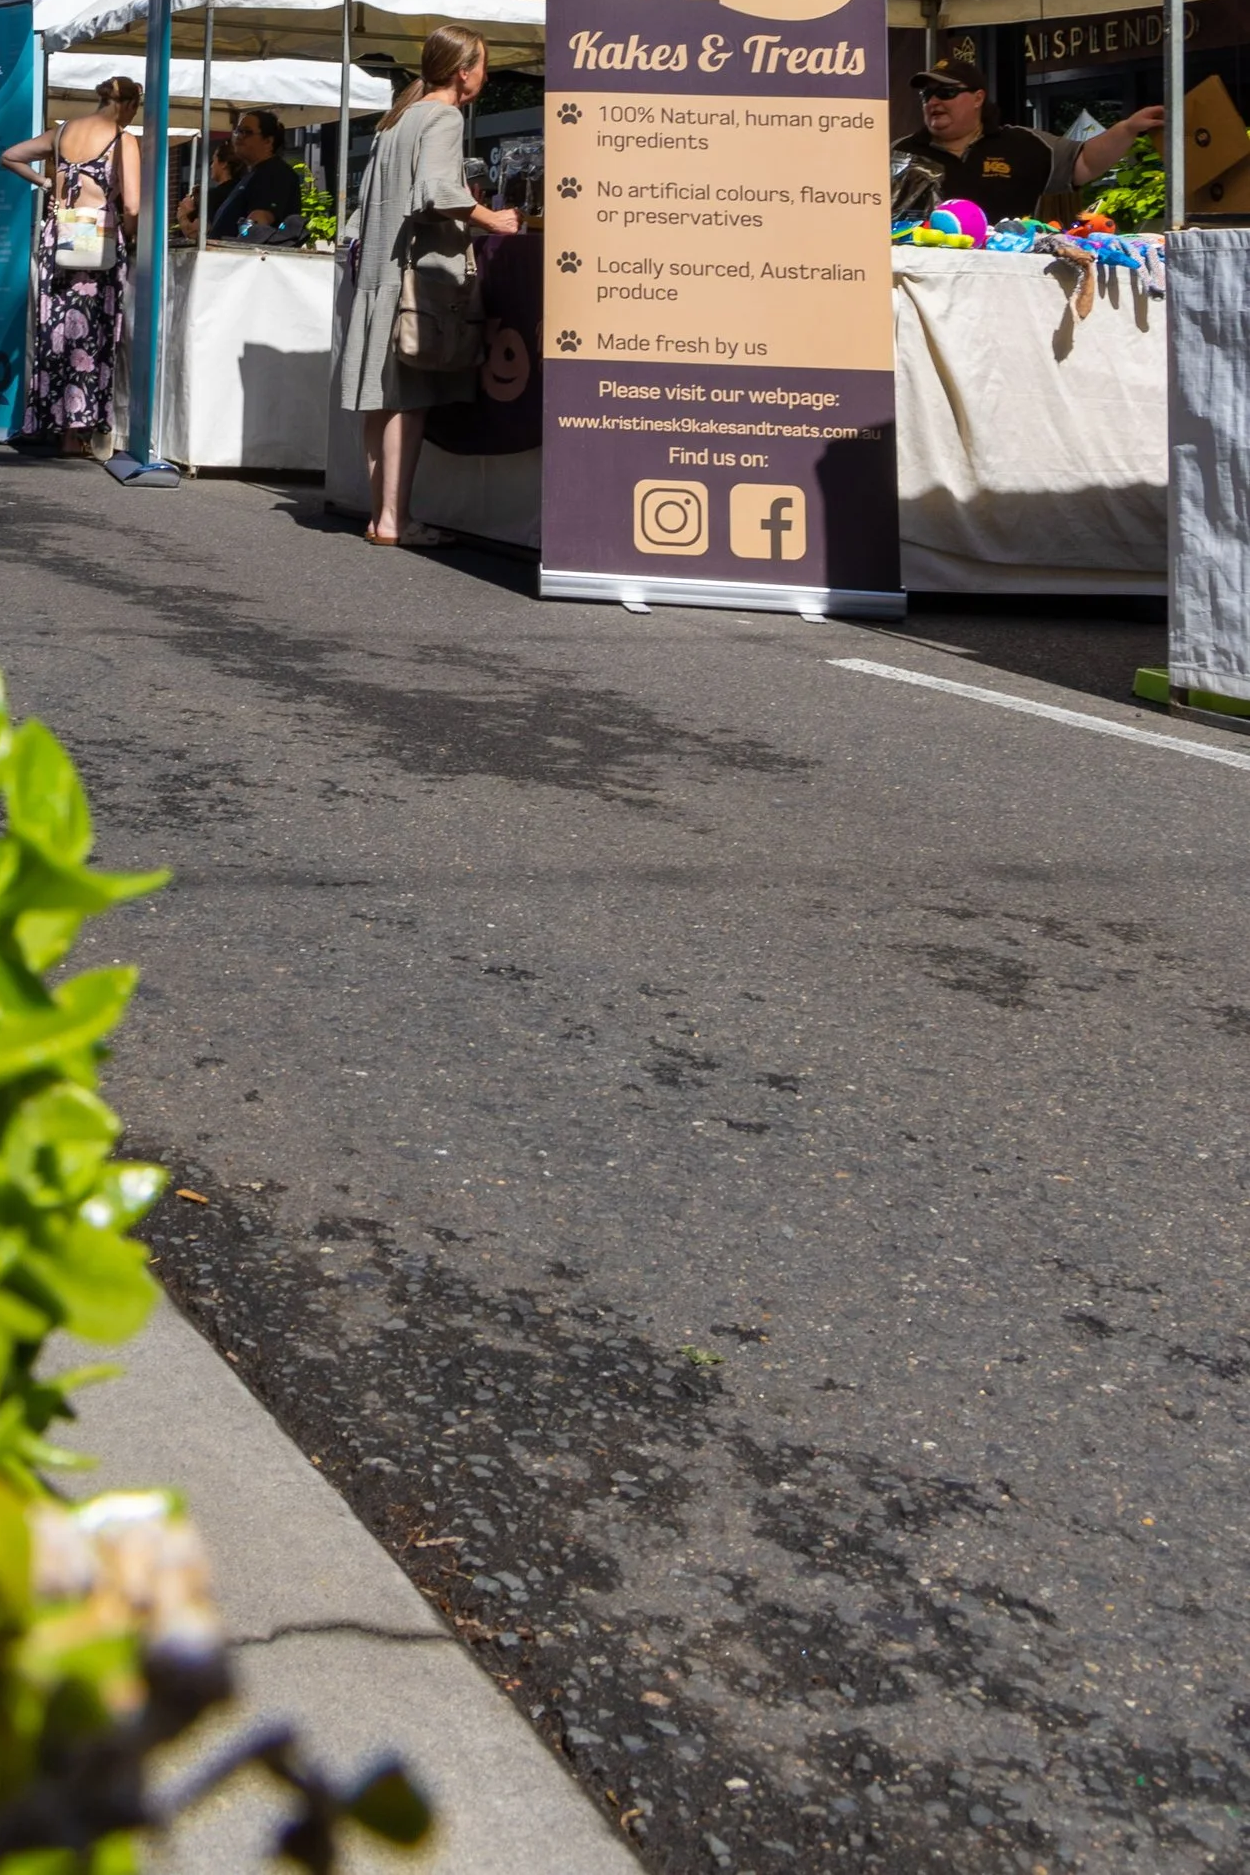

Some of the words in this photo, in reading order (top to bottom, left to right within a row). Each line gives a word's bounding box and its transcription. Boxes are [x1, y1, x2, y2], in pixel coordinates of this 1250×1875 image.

[568, 30, 689, 71] Kakes
[697, 33, 734, 73] &
[742, 34, 867, 76] Treats
[598, 105, 655, 124] 100%
[661, 107, 740, 129] Natural,
[745, 109, 813, 128] human
[817, 112, 875, 133] grade
[596, 130, 710, 152] ingredients
[596, 180, 623, 198] No
[627, 182, 711, 201] artificial
[715, 184, 795, 205] colours,
[799, 185, 882, 206] flavours
[596, 208, 619, 223] or
[623, 208, 764, 228] preservatives
[596, 256, 664, 280] Locally
[668, 261, 755, 281] sourced,
[760, 261, 866, 282] Australian
[596, 283, 679, 303] produce
[596, 332, 651, 351] Made
[655, 334, 710, 354] fresh
[715, 337, 740, 359] by
[744, 341, 768, 356] us
[599, 381, 661, 401] Please
[664, 383, 706, 402] visit
[710, 387, 744, 404] our
[748, 387, 840, 411] webpage:
[558, 414, 882, 441] www.kristinesk9kakesandtreats.com.au
[668, 446, 709, 466] Find
[712, 451, 737, 467] us
[740, 453, 770, 469] on:
